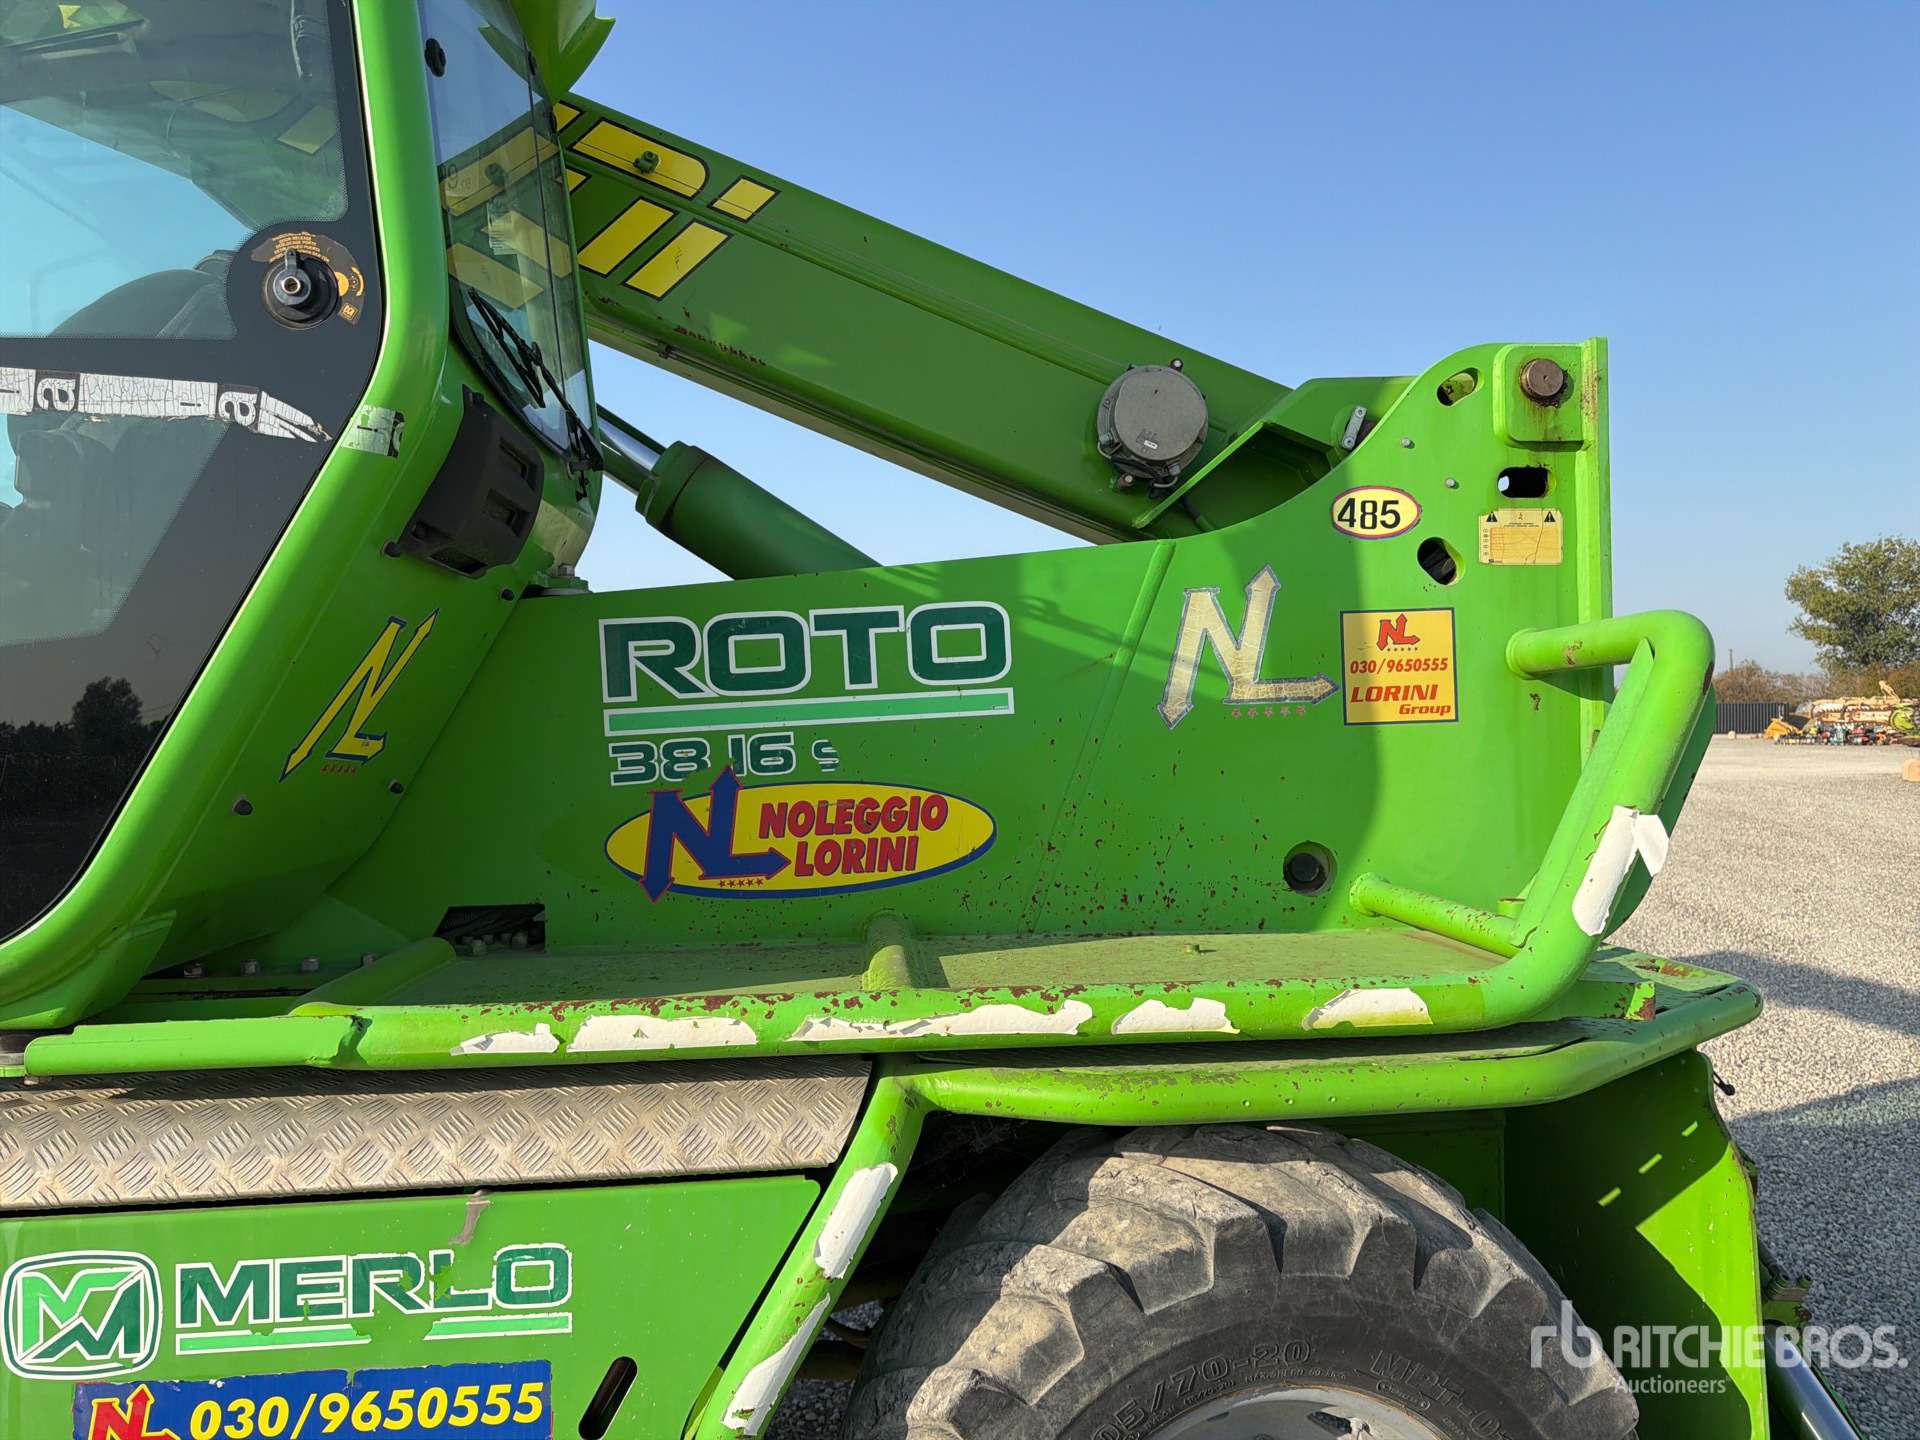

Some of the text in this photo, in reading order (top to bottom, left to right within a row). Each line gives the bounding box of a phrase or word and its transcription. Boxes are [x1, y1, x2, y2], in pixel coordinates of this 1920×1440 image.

[1337, 497, 1401, 530] 485
[599, 600, 1012, 703] ROTO
[1349, 657, 1449, 675] 030/9650555
[1350, 683, 1439, 704] LORINI
[1398, 703, 1452, 718] Group
[609, 737, 711, 786] 38
[758, 794, 949, 839] NOLEGGIO
[794, 835, 920, 878] LORINI
[176, 1243, 573, 1329] MERLO
[189, 1381, 545, 1440] 030/9650555
